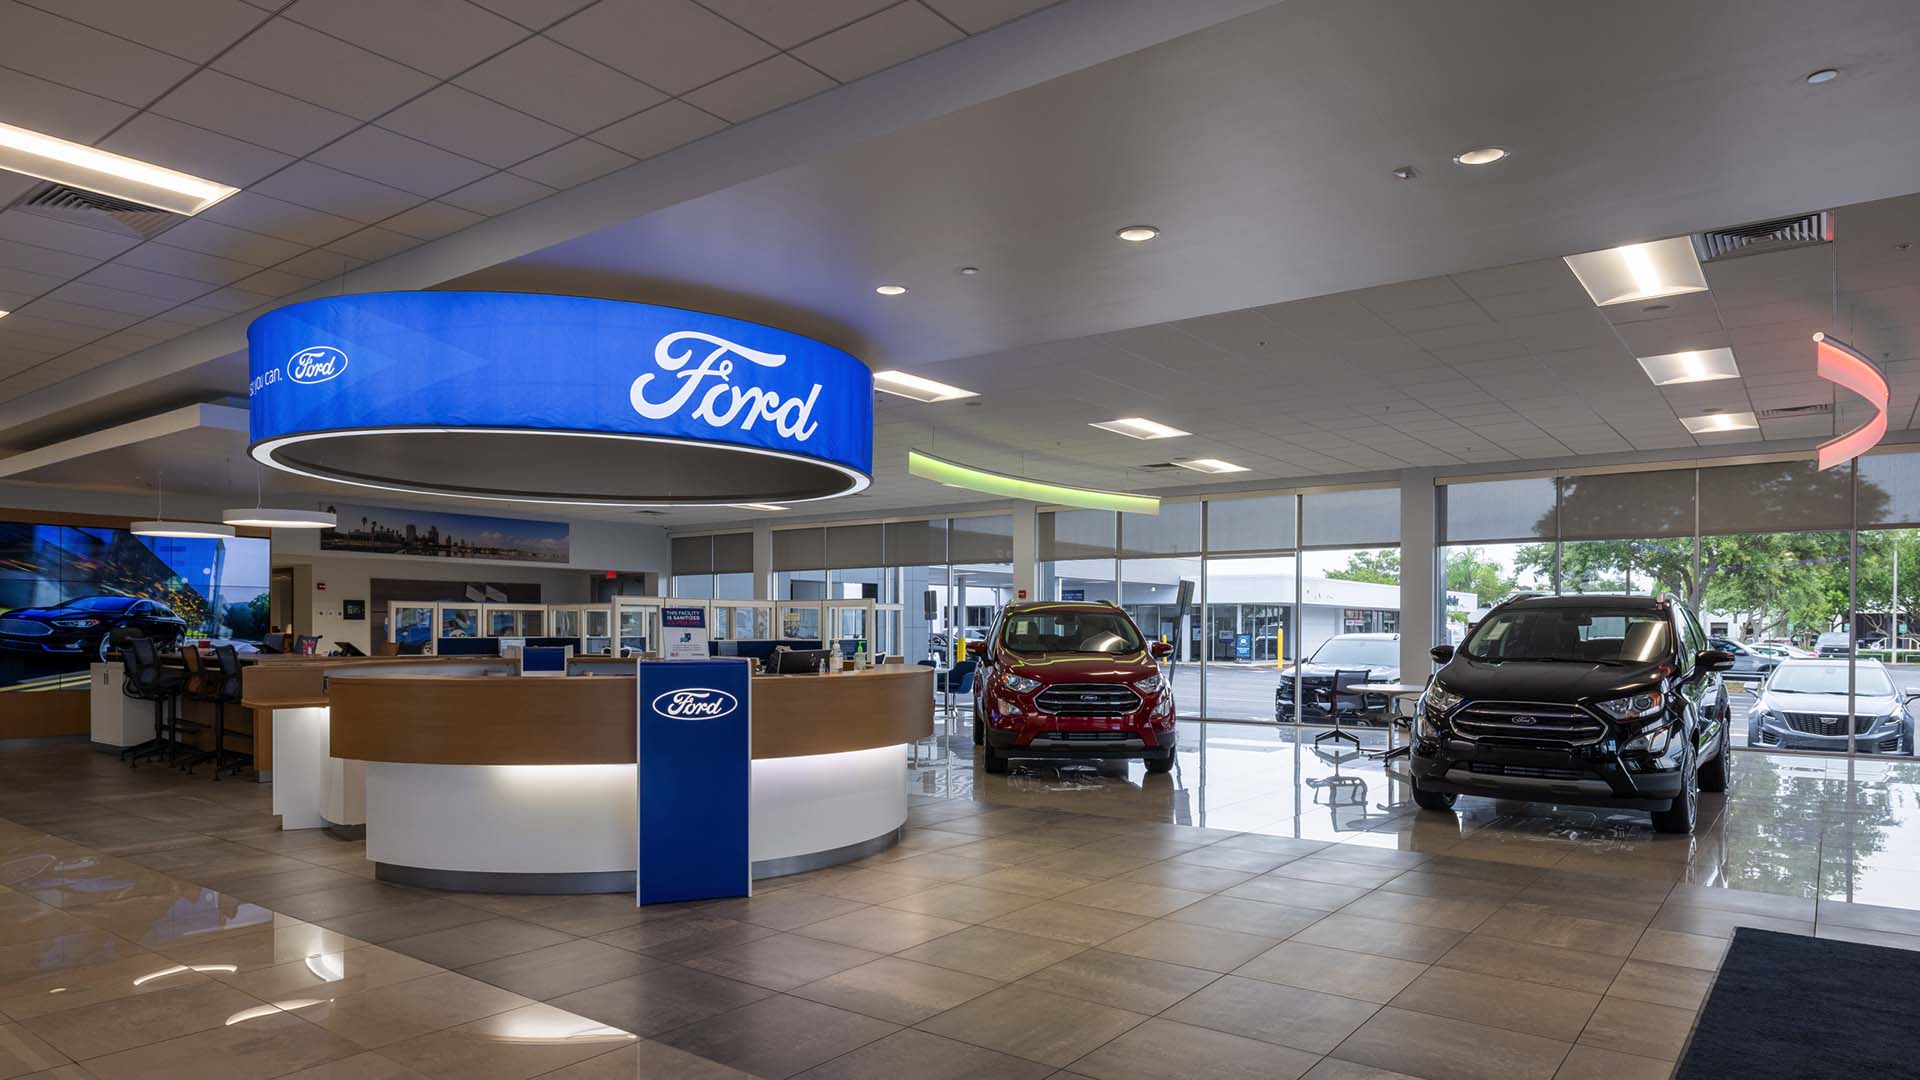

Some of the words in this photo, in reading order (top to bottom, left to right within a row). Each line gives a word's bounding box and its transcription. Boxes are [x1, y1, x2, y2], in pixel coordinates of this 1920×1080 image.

[264, 367, 283, 386] can.
[293, 350, 337, 380] Ford
[629, 330, 823, 442] Ford
[666, 691, 726, 716] Ford
